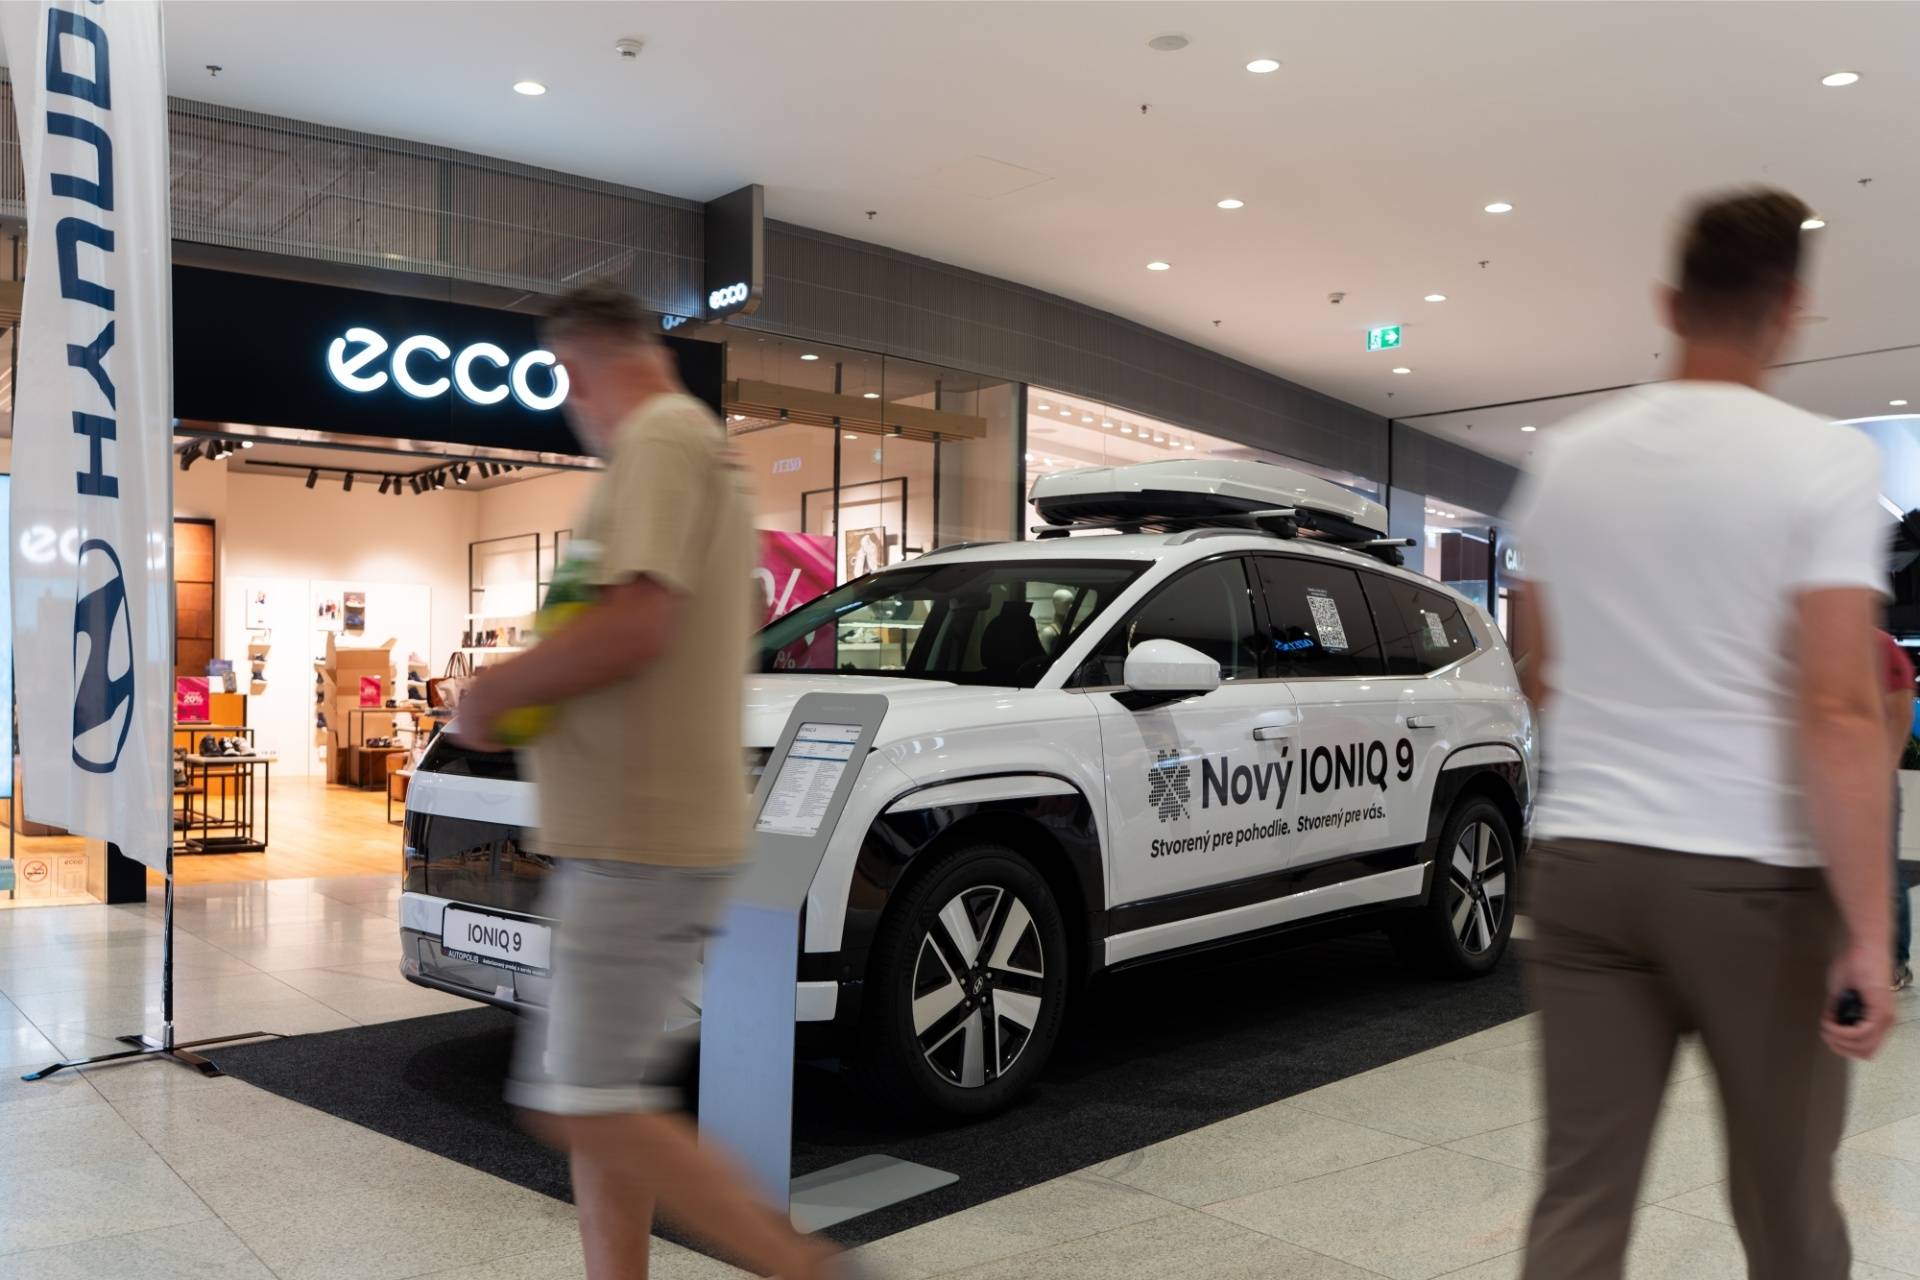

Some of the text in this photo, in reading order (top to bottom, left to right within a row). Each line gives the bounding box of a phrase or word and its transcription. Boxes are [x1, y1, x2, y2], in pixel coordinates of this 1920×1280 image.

[46, 0, 119, 499] HYUND
[709, 282, 748, 310] ecco
[327, 327, 570, 411] ecco
[1201, 737, 1415, 810] Nový IONIQ 9
[1150, 802, 1386, 859] Stvorený pre pohodlie. Stvorený pre vás.
[467, 923, 522, 953] IONIQ 9
